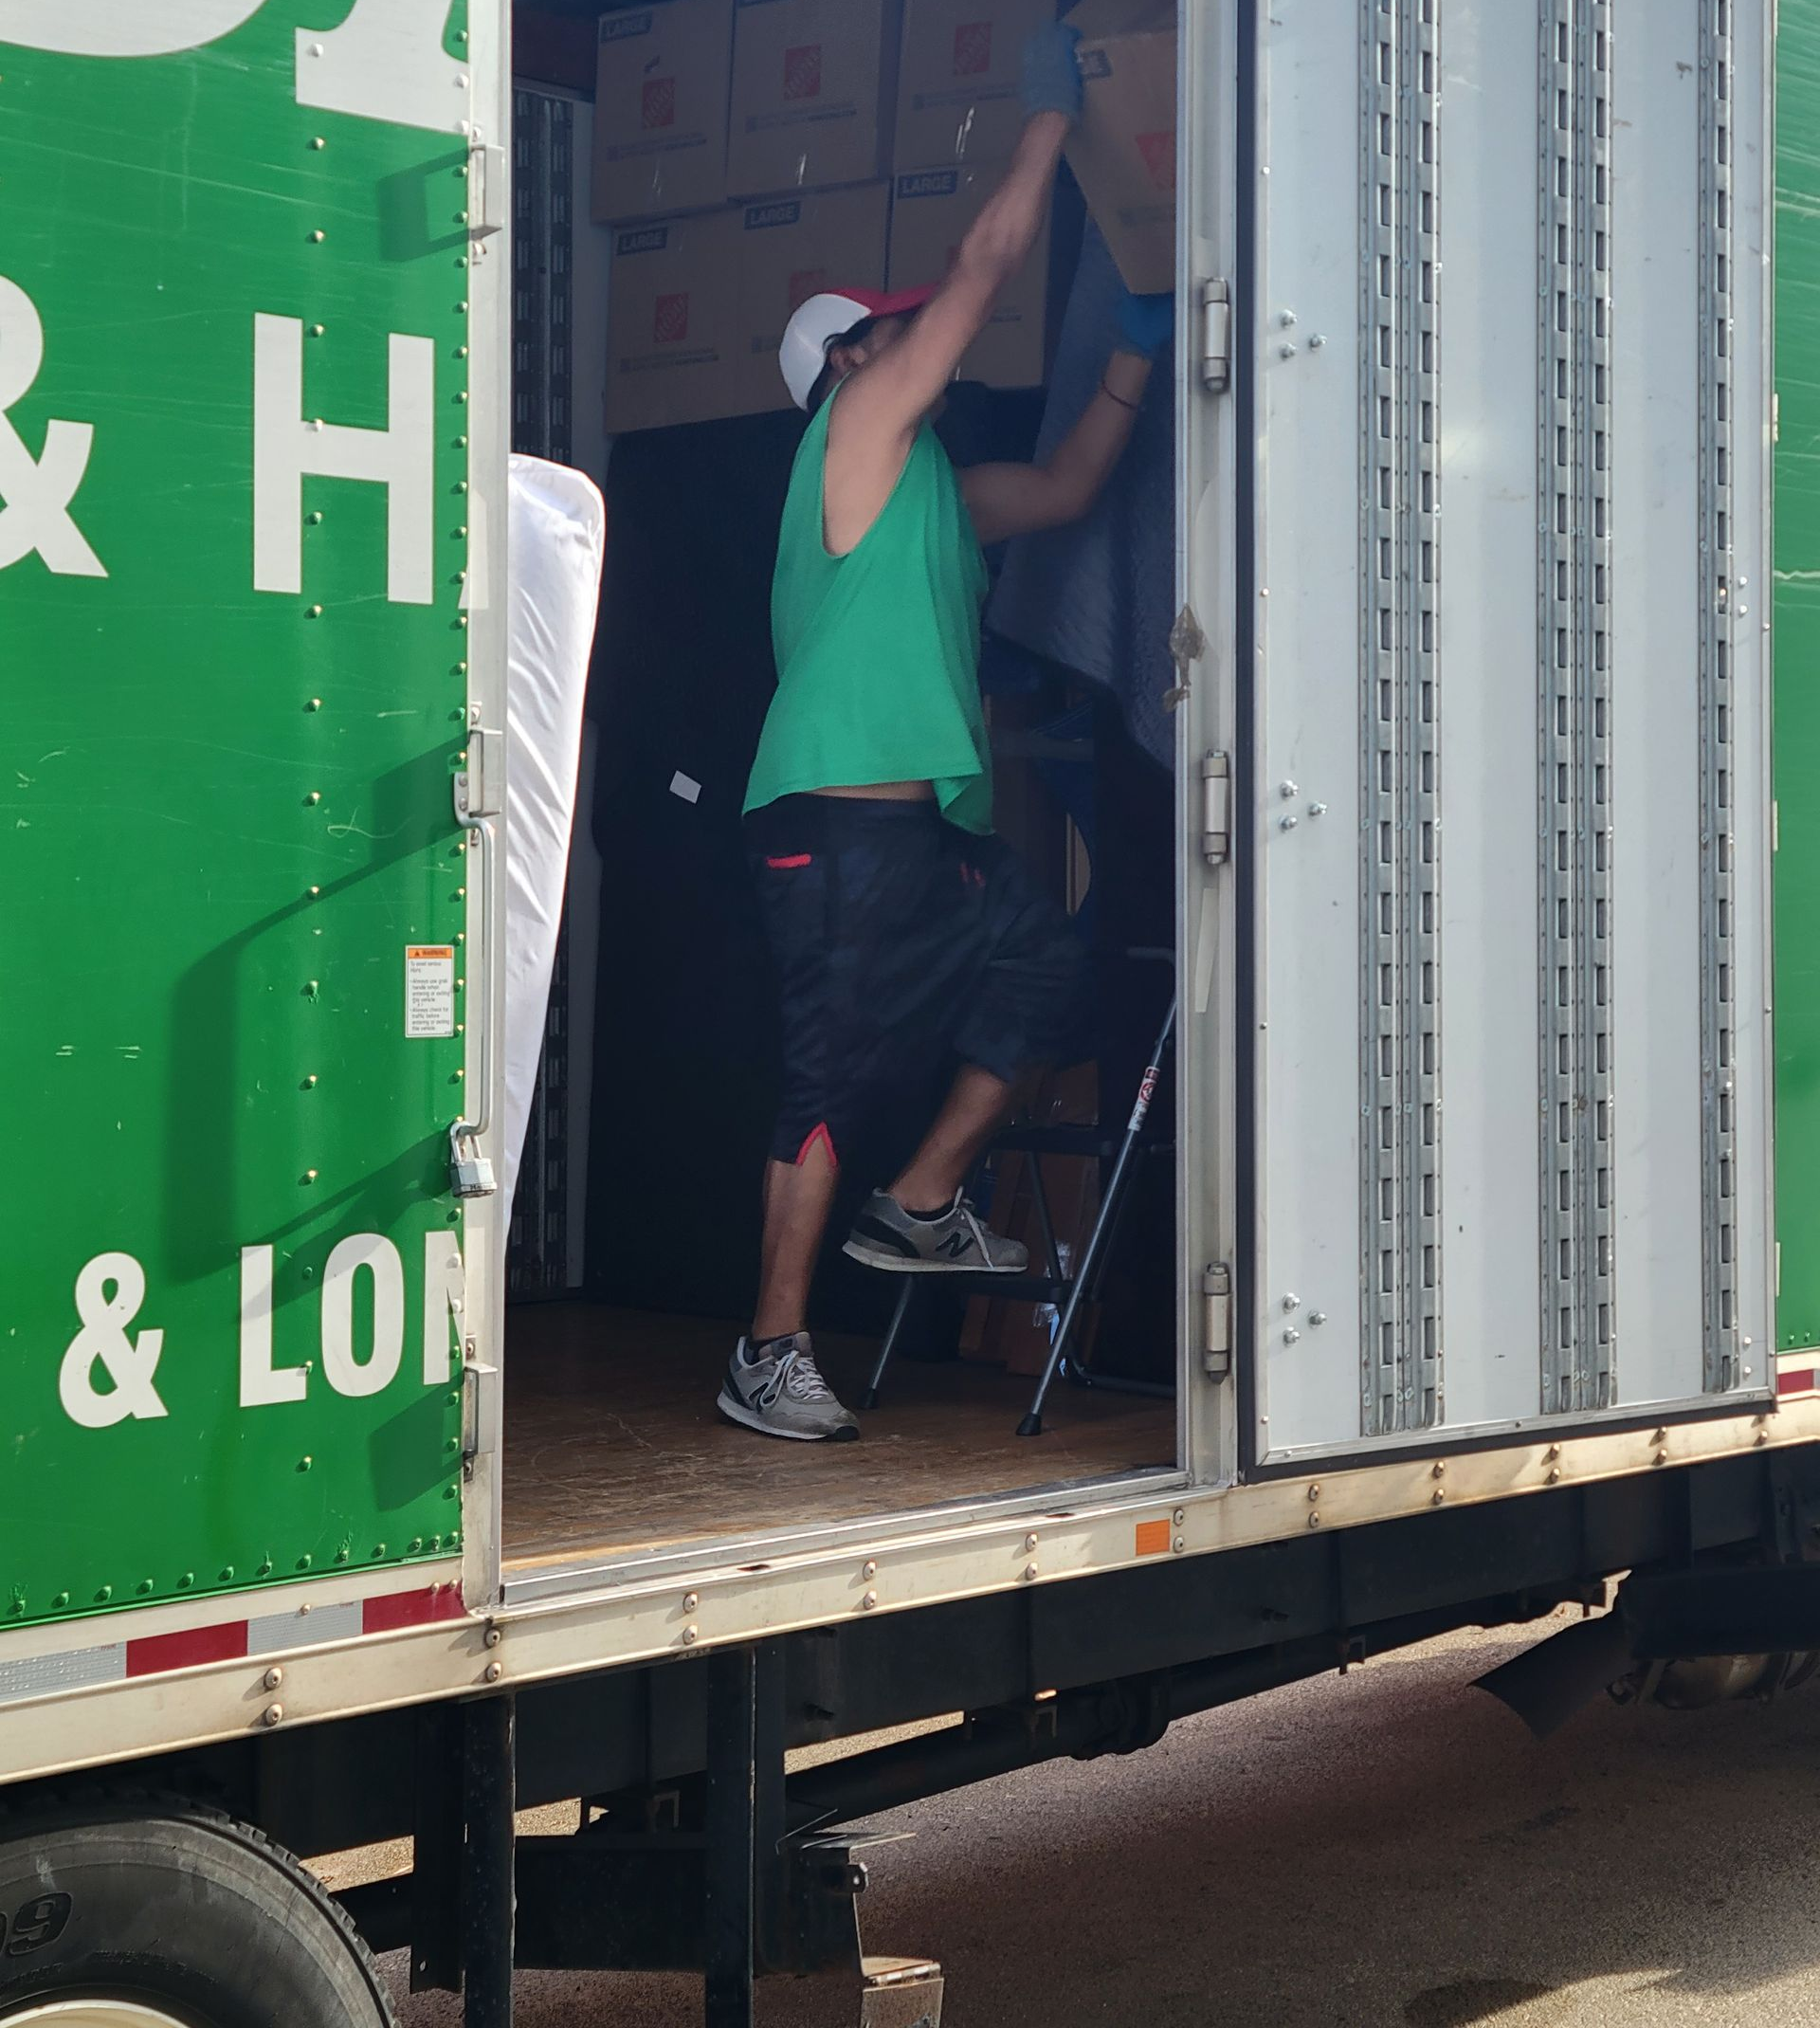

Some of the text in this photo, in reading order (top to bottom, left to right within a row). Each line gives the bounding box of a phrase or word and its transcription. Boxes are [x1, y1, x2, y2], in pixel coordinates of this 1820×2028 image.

[901, 172, 953, 195] LARGE
[253, 312, 489, 610] H
[59, 1252, 169, 1428] &
